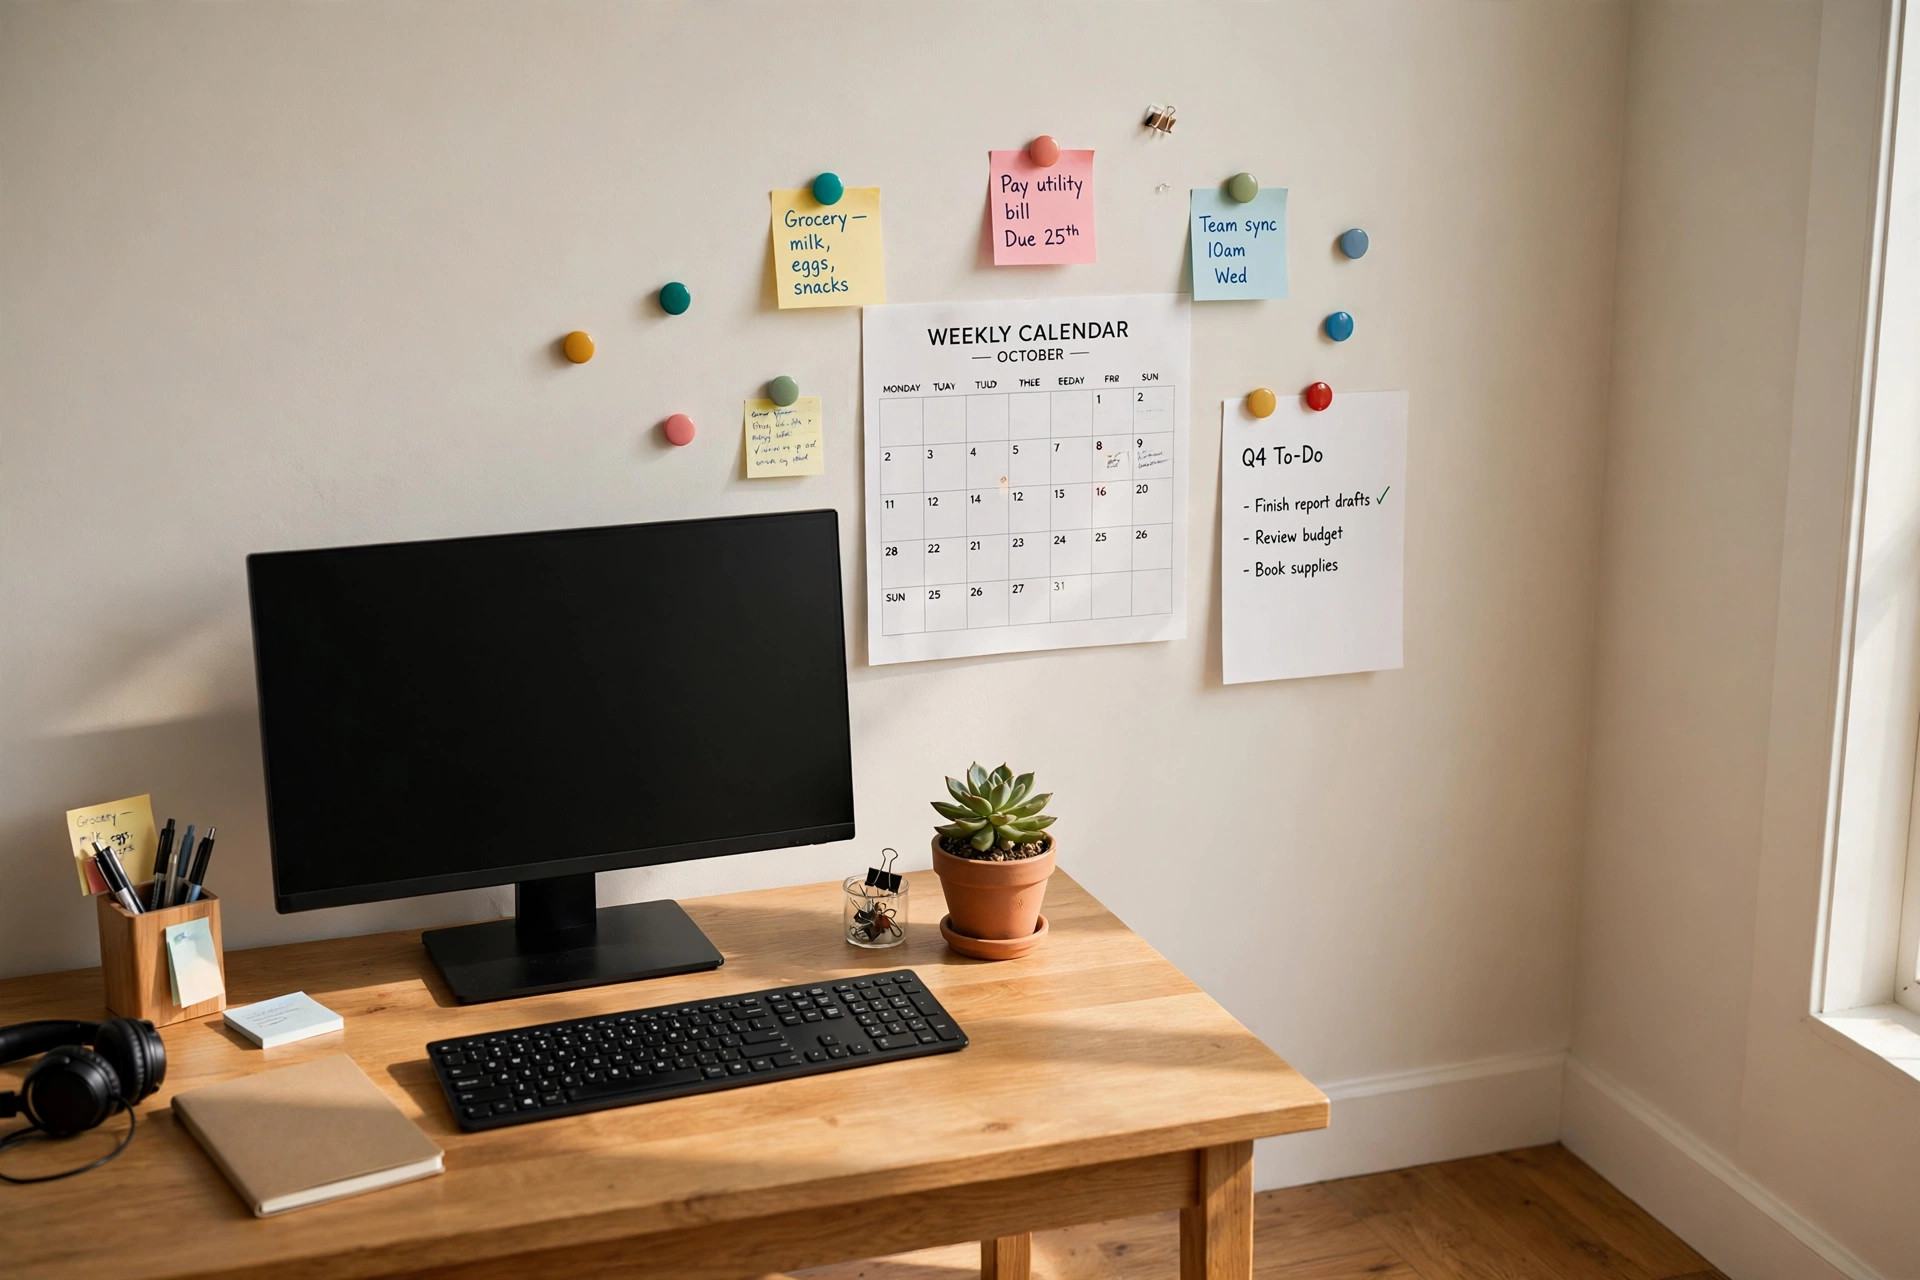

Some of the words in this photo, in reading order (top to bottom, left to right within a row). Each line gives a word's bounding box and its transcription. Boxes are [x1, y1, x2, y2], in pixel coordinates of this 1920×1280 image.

[1001, 175, 1028, 199] Pay
[1037, 174, 1082, 199] utility
[1005, 203, 1029, 219] bill
[785, 210, 847, 232] Grocery
[1199, 216, 1237, 232] Team
[1245, 221, 1277, 238] sync
[1005, 230, 1036, 247] Due
[1045, 224, 1079, 245] 25th
[790, 234, 830, 252] milk,
[1209, 242, 1245, 258] 10am
[792, 259, 834, 278] eggs,
[1215, 267, 1247, 283] Wed
[795, 276, 848, 295] snacks
[928, 326, 1011, 345] WEEKLY
[1019, 321, 1128, 341] CALENDAR
[998, 348, 1063, 362] OCTOBER
[1018, 378, 1041, 387] THEE
[1058, 377, 1085, 386] EEDAY
[1141, 373, 1159, 382] SUN
[882, 384, 921, 394] MONDAY
[1096, 395, 1101, 405] 1
[1137, 393, 1144, 402] 2
[1054, 443, 1061, 453] 7
[1095, 441, 1103, 451] 8
[1136, 439, 1144, 449] 9
[926, 450, 934, 460] 3
[969, 448, 977, 457] 4
[1012, 445, 1019, 455] 5
[884, 452, 891, 462] 2
[1242, 447, 1266, 468] Q4
[1273, 445, 1323, 464] To-Do
[1054, 489, 1065, 499] 15
[1095, 487, 1107, 497] 16
[1135, 484, 1149, 495] 20
[927, 497, 939, 507] 12
[970, 495, 982, 504] 14
[1012, 492, 1024, 502] 12
[884, 500, 895, 510] 11
[1256, 497, 1289, 512] Finish
[1295, 495, 1330, 514] report
[1335, 492, 1370, 507] drafts
[1095, 533, 1107, 543] 25
[1135, 530, 1148, 540] 26
[1256, 530, 1296, 544] Review
[1303, 526, 1343, 546] budget
[1012, 538, 1025, 548] 23
[1053, 536, 1067, 545] 24
[927, 544, 941, 554] 22
[970, 541, 981, 551] 21
[885, 547, 899, 557] 28
[1256, 561, 1285, 577] Book
[1291, 558, 1338, 578] supplies
[1012, 584, 1025, 594] 27
[1053, 582, 1065, 591] 31
[928, 590, 941, 600] 25
[970, 587, 983, 597] 26
[885, 593, 906, 603] SUN
[76, 813, 117, 827] Grocery
